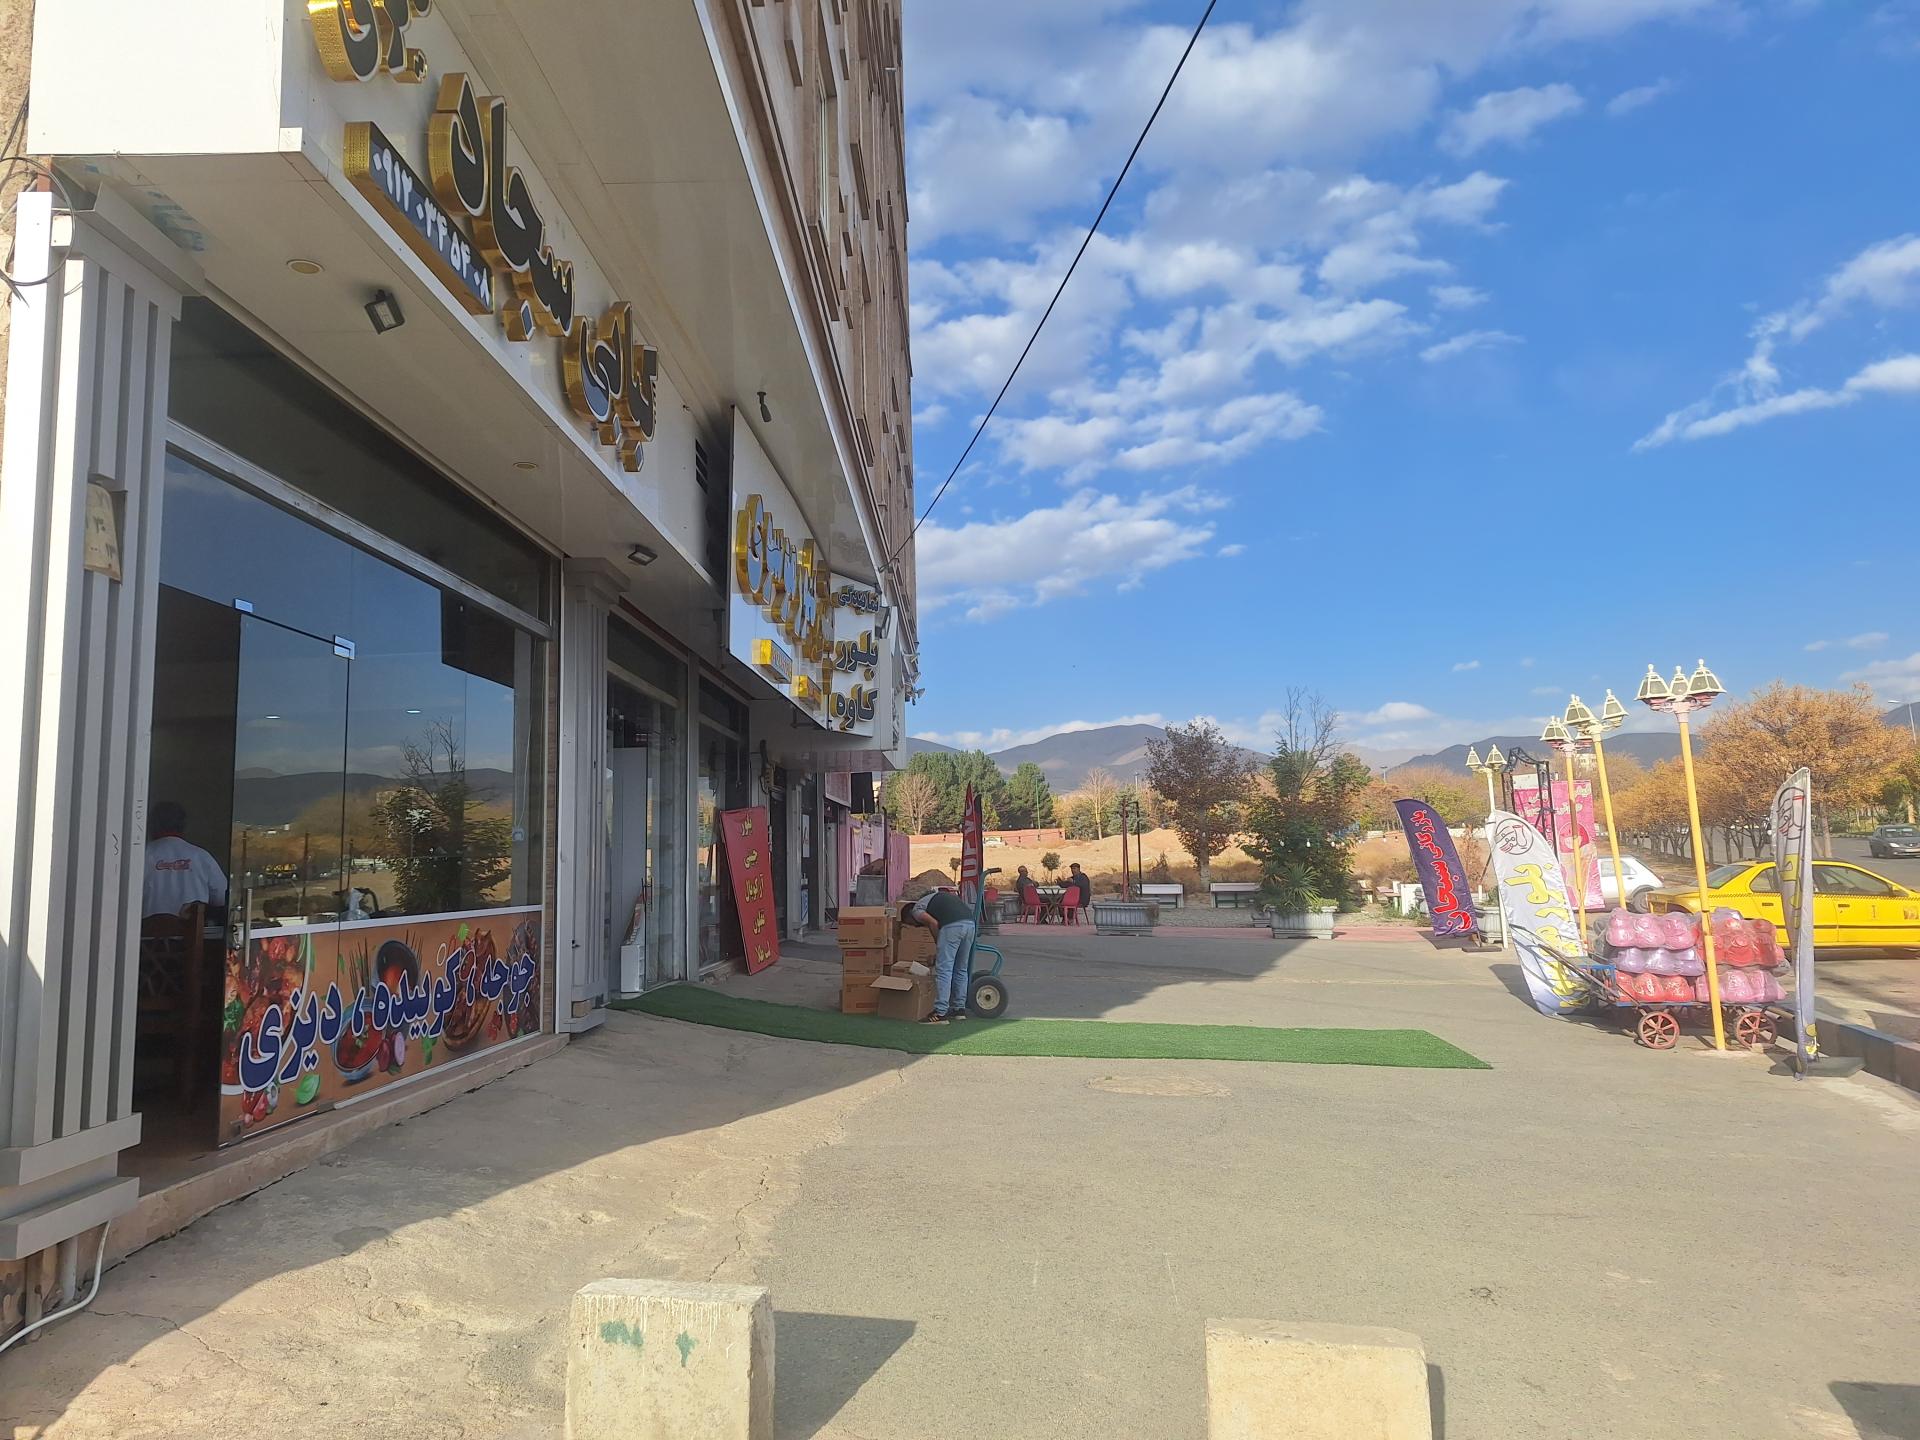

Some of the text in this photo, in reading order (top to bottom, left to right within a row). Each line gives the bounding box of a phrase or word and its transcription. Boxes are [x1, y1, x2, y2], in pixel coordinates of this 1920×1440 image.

[372, 147, 413, 213] ۰۹۱۲
[440, 72, 659, 473] کبابی سجاد
[838, 585, 879, 614] نمایندگی
[834, 630, 879, 681] بلور
[832, 684, 879, 730] کاوه
[1410, 809, 1472, 931] بازرگانی سبحان
[1504, 863, 1570, 922] بلور
[238, 981, 342, 1093] دیزی
